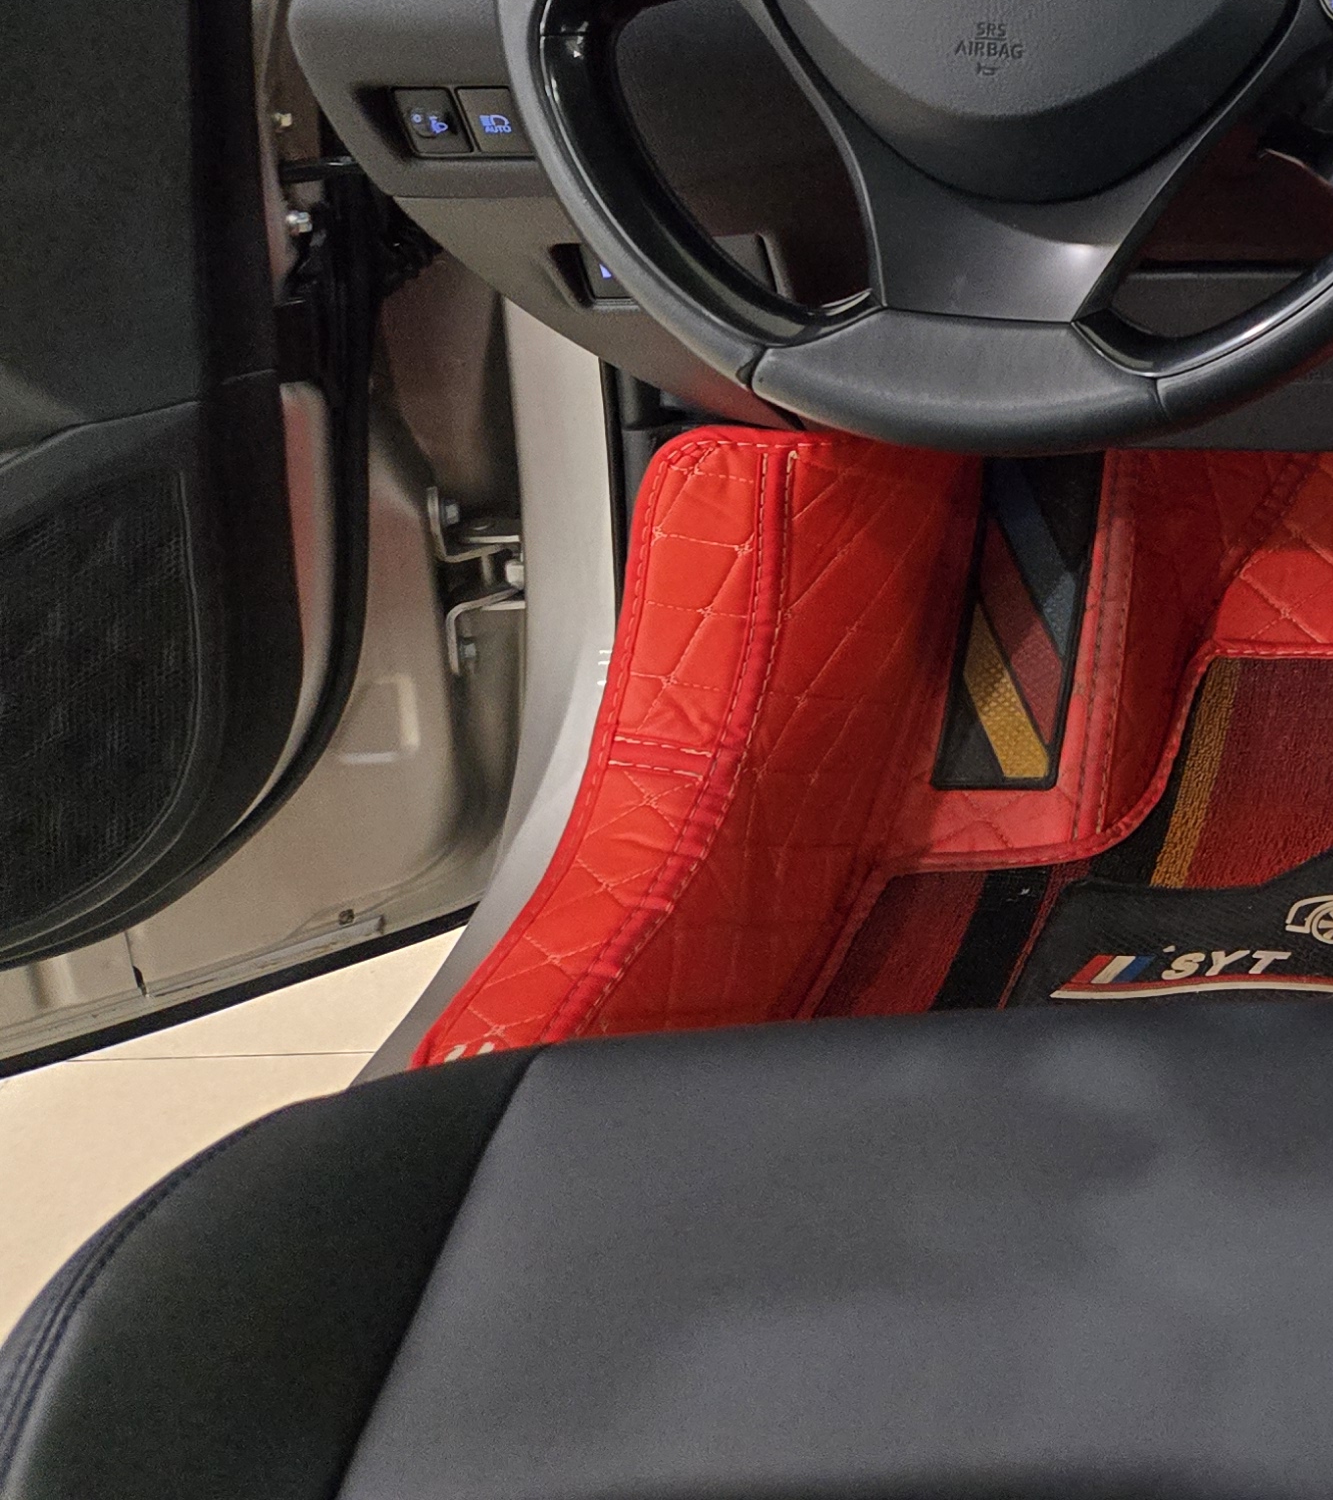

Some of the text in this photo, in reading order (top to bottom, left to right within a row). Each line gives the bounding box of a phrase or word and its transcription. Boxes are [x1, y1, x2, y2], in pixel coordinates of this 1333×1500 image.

[976, 21, 1007, 37] SRS
[954, 40, 1024, 59] AIRBAG
[485, 125, 512, 133] AUTO
